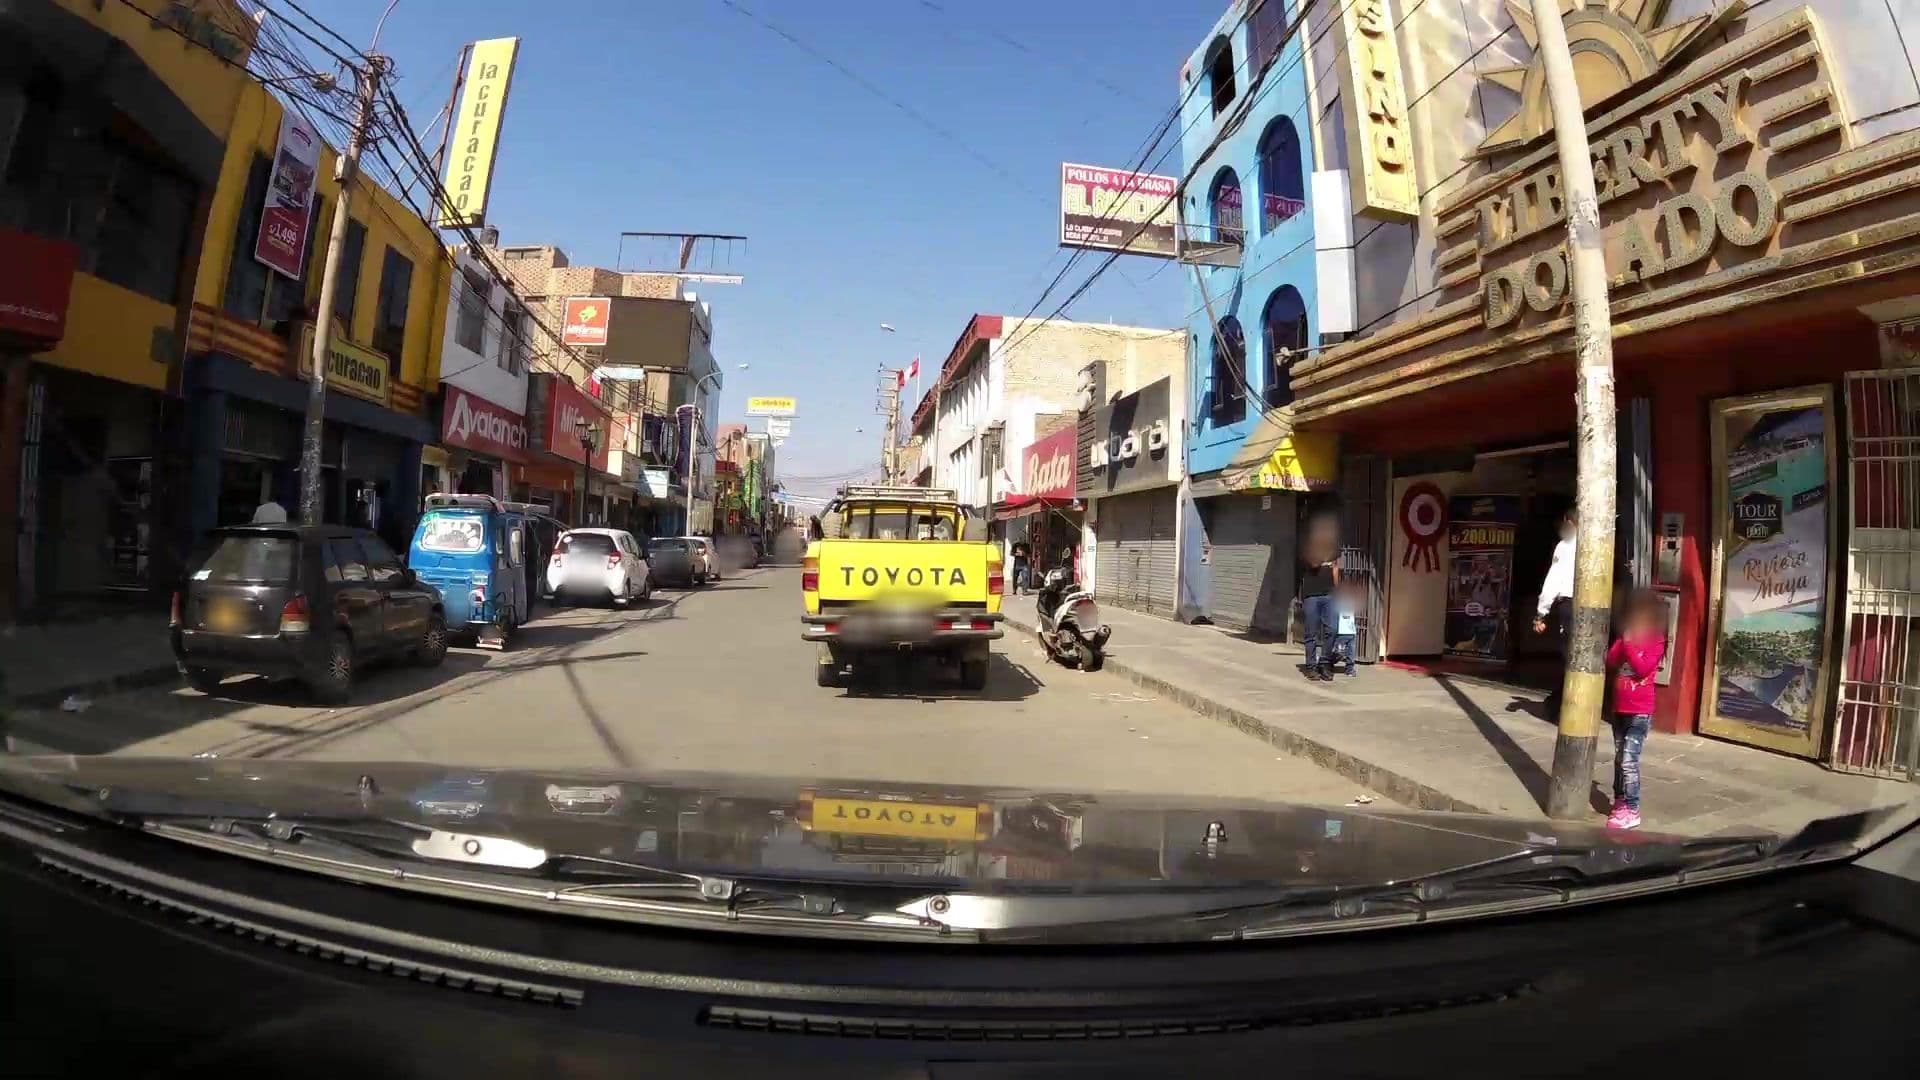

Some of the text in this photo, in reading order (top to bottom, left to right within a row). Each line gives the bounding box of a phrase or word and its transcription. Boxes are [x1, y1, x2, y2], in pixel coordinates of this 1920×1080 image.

[456, 62, 498, 210] la curacao
[1068, 168, 1109, 185] POLLOS
[1480, 171, 1778, 329] DOADO
[327, 350, 381, 390] curacao
[446, 393, 528, 449] Avalanch
[1026, 446, 1071, 496] Bata
[1736, 503, 1777, 518] TOUR
[841, 566, 966, 586] TOYOTA
[1752, 573, 1809, 603] Maya
